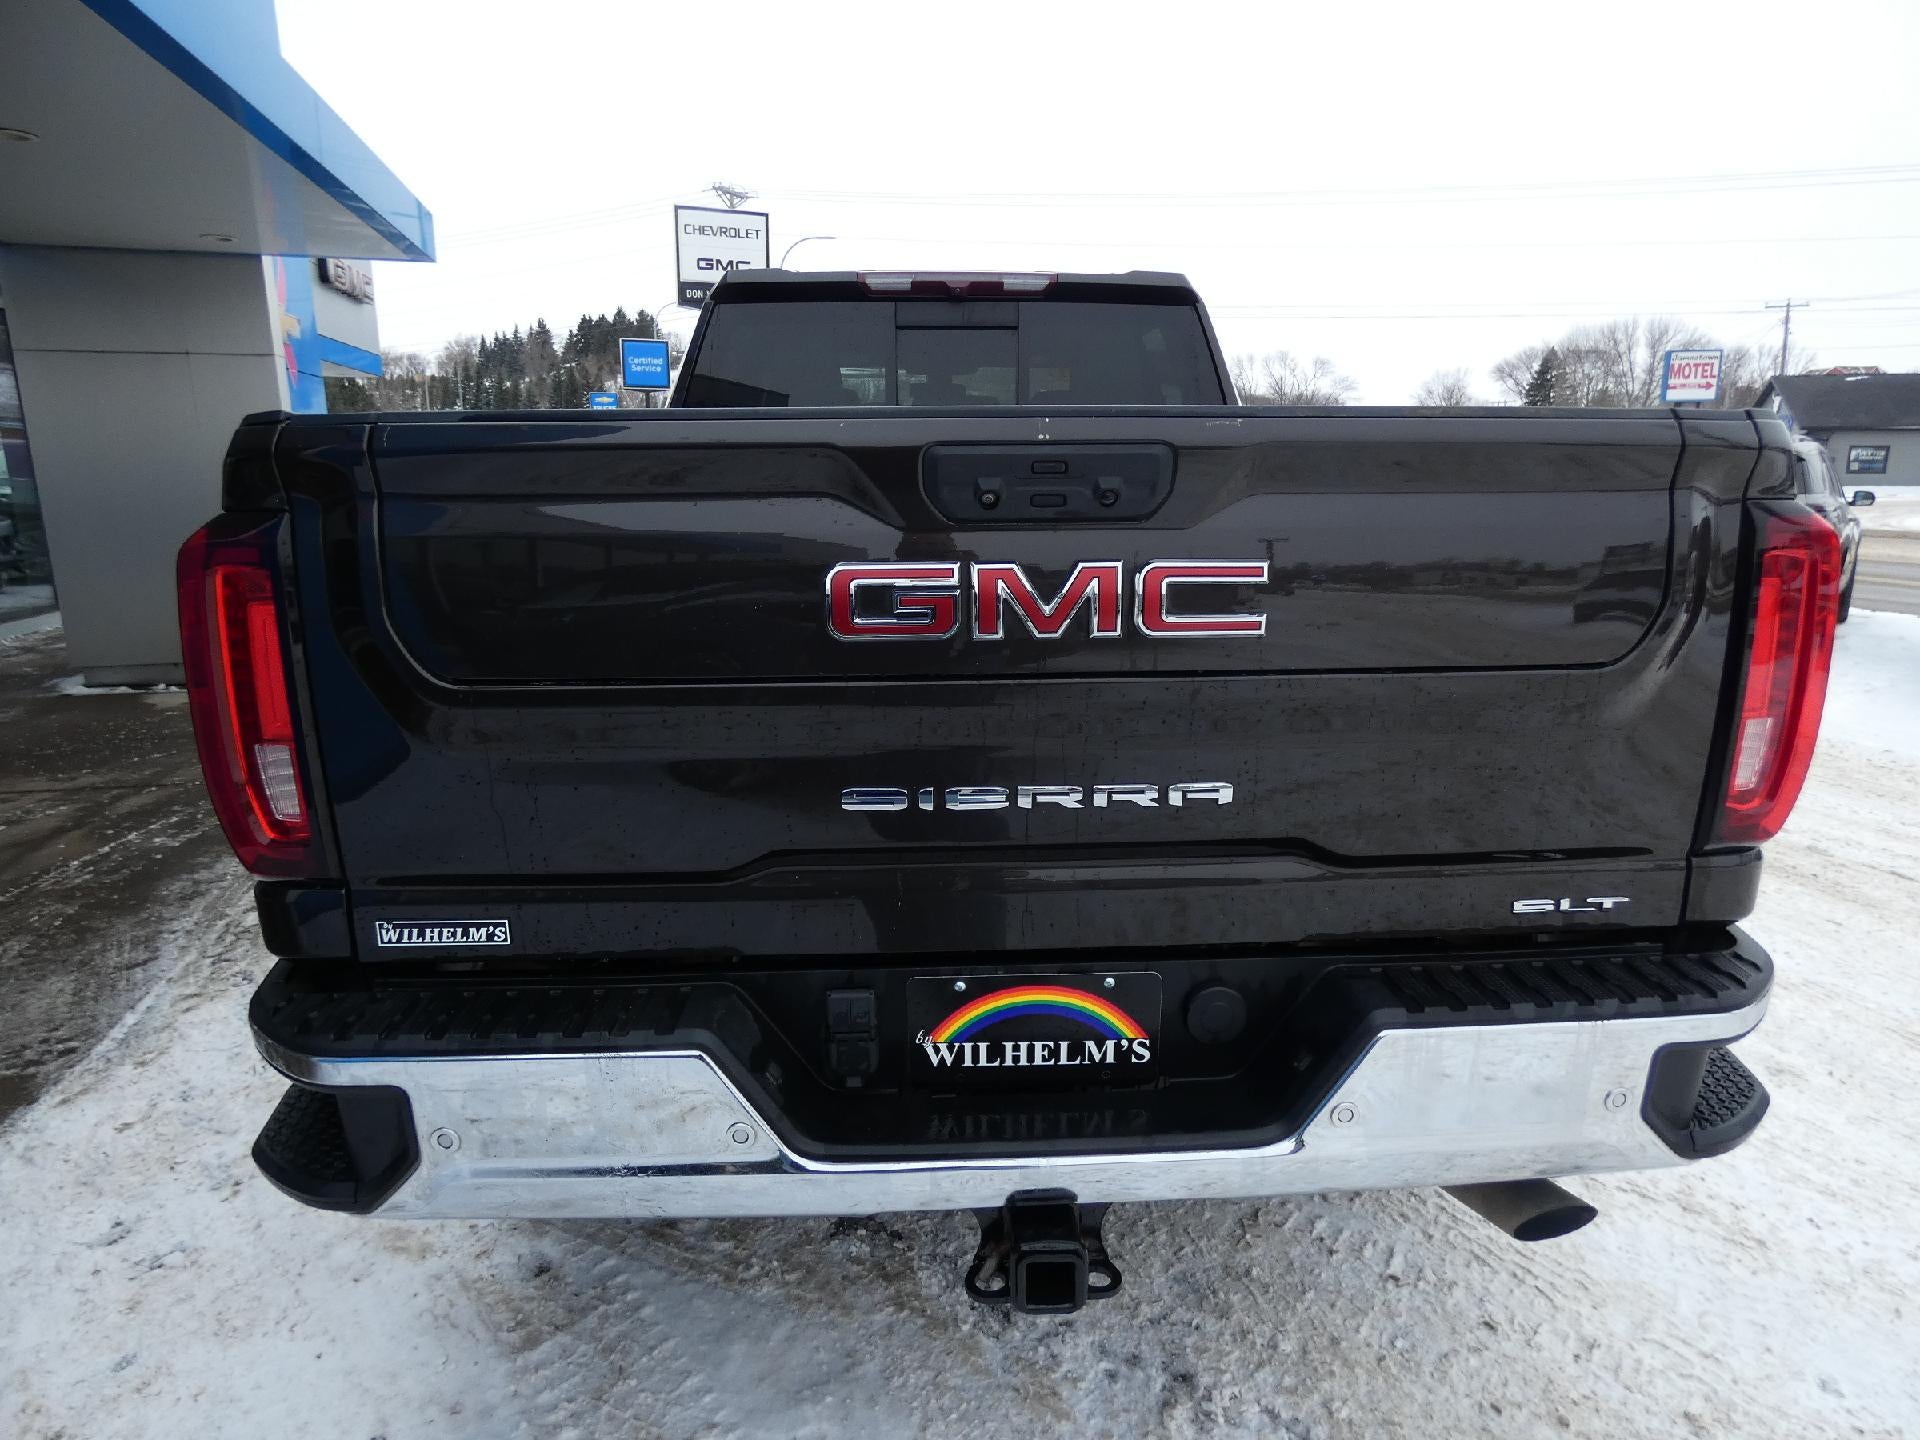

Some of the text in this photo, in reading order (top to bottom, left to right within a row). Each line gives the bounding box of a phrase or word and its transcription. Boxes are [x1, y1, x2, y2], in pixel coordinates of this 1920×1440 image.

[684, 223, 761, 240] CHEVROLET
[697, 257, 751, 271] GMC
[686, 289, 703, 299] DON
[628, 356, 663, 366] Certified
[631, 364, 662, 373] Service
[1669, 362, 1716, 379] MOTEL
[825, 559, 1270, 641] GMC
[841, 781, 1235, 811] SIERRA
[1513, 896, 1631, 913] SLT
[381, 925, 507, 943] WILHELM'S
[383, 921, 394, 930] by
[915, 1029, 934, 1048] by
[925, 1038, 1151, 1067] WILHELM'S
